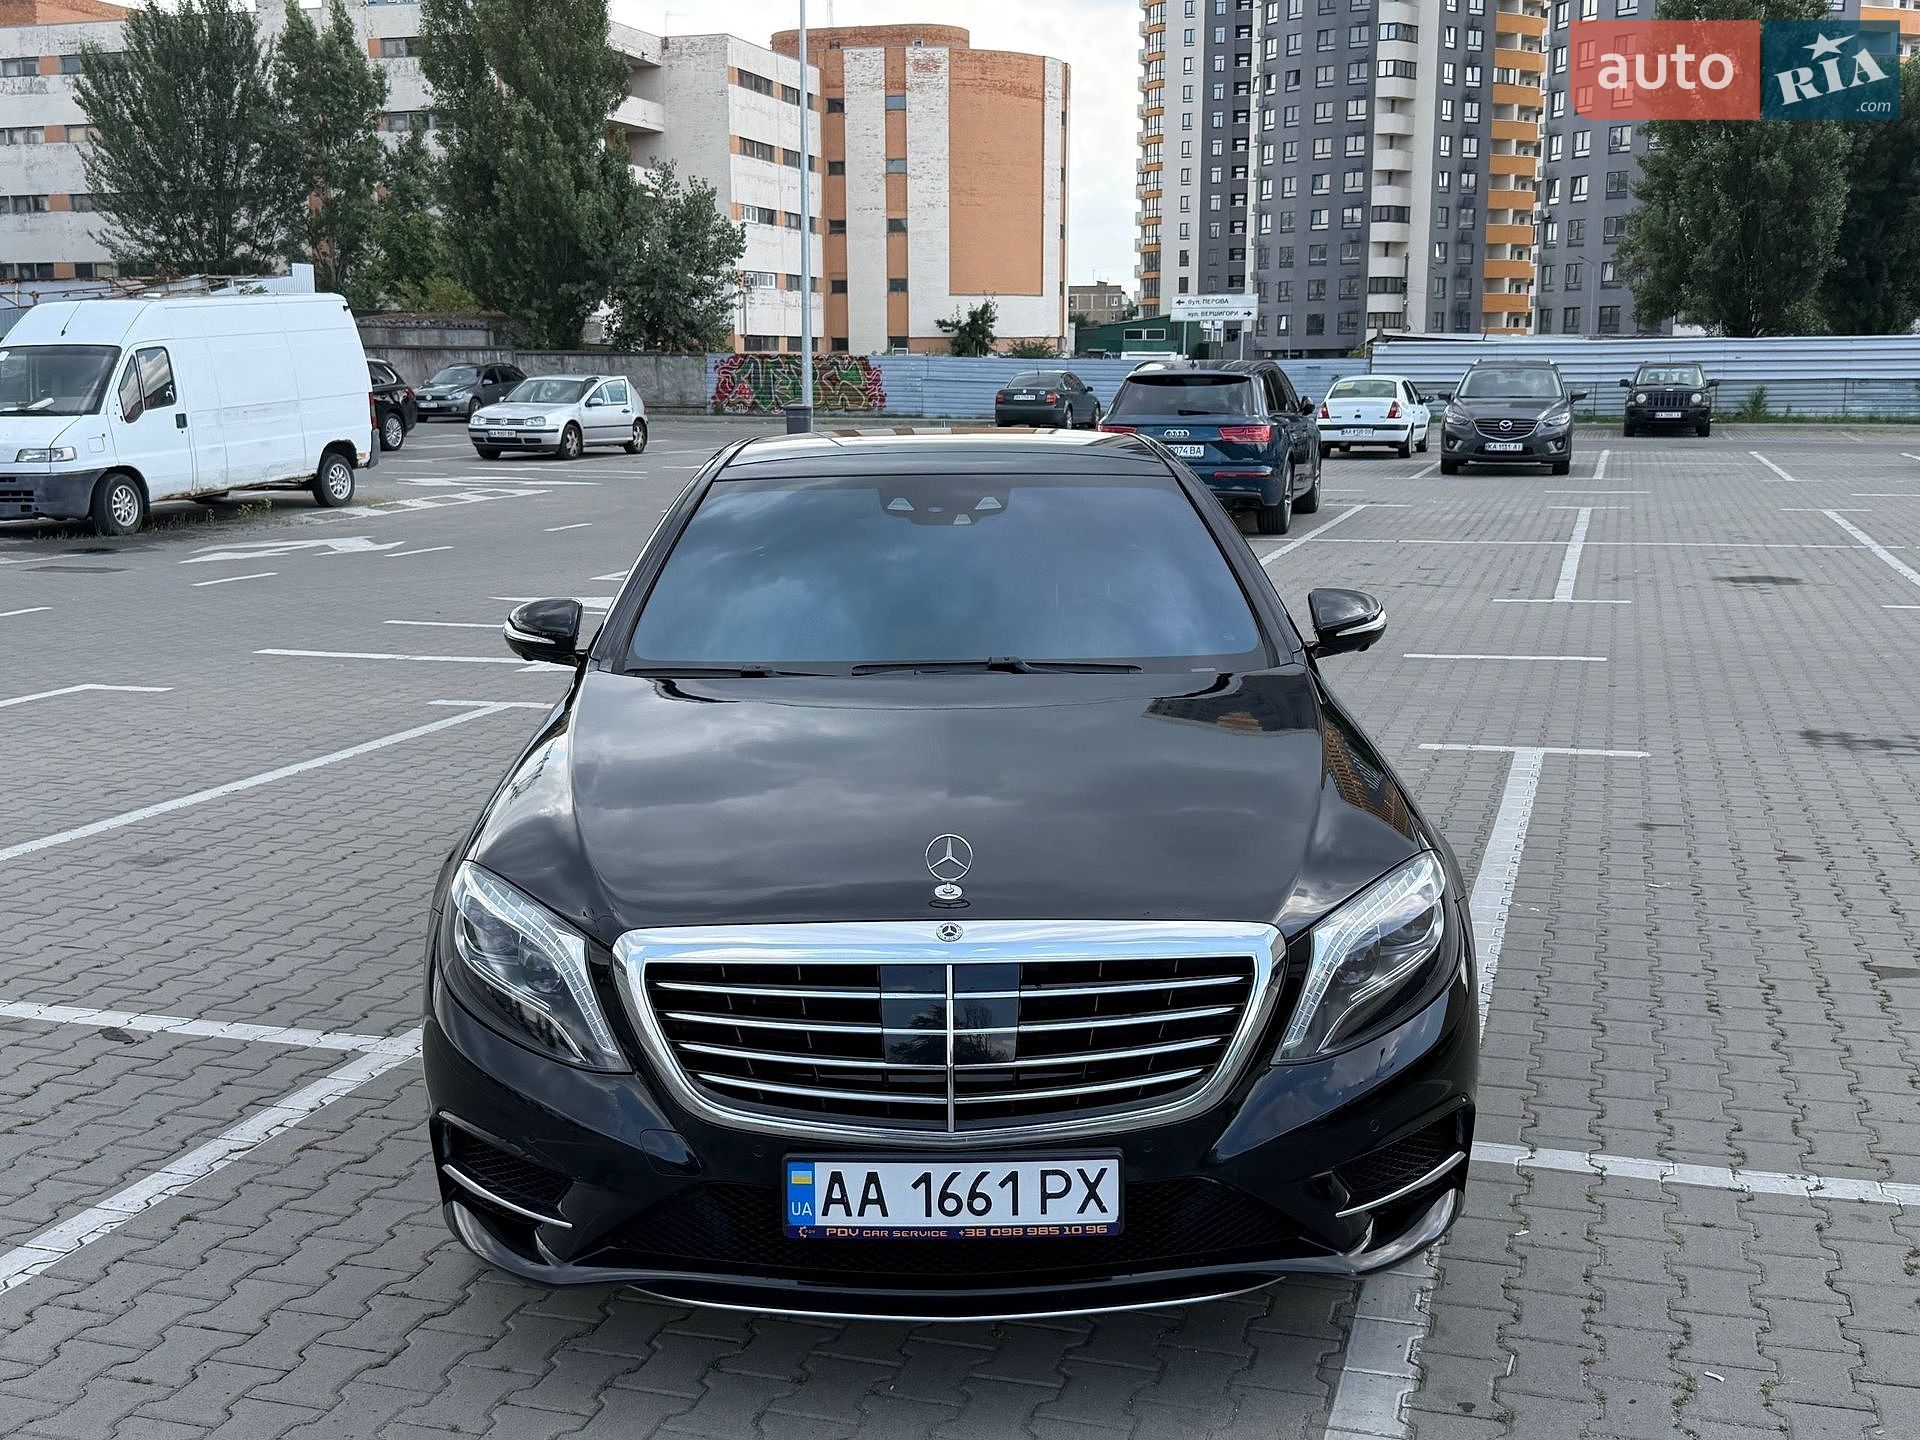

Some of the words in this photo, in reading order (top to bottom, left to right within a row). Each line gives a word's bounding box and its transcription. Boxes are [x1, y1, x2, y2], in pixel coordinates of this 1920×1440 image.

[1189, 445, 1202, 455] BA
[820, 1170, 889, 1218] AA
[910, 1170, 1019, 1218] 1661
[1040, 1167, 1109, 1215] PX
[791, 1203, 812, 1217] UA
[826, 1228, 859, 1237] PDV
[863, 1229, 889, 1237] CAR
[892, 1230, 948, 1238] SERVICE
[959, 1228, 987, 1237] +38
[990, 1227, 1024, 1237] 098
[1026, 1226, 1060, 1236] 985
[1063, 1225, 1082, 1235] 10
[1085, 1224, 1108, 1234] 96
